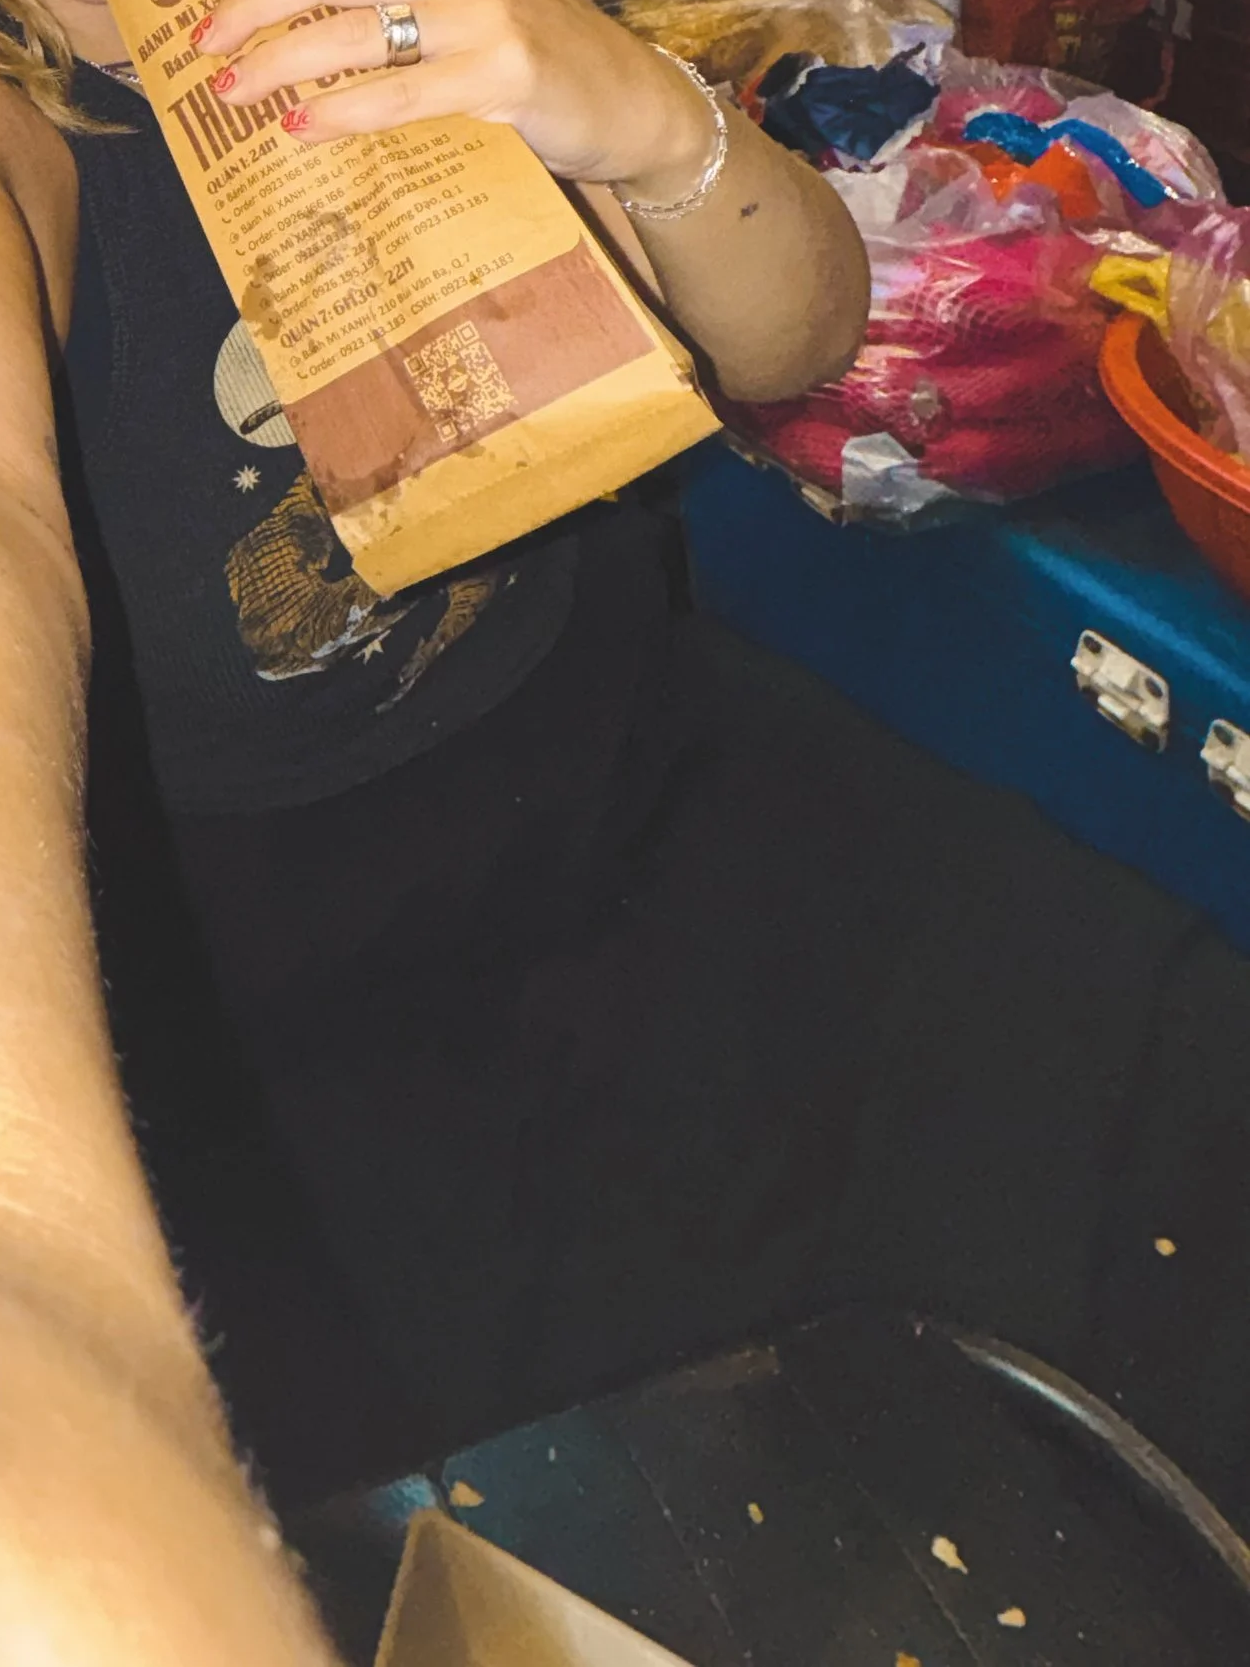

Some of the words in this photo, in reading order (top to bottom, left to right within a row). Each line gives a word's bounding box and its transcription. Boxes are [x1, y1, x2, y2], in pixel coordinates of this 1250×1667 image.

[138, 22, 174, 63] BÁNH
[174, 5, 198, 31] MÌ
[259, 156, 287, 178] XANH
[276, 188, 306, 210] XANH
[333, 282, 378, 316] 6H30
[384, 257, 414, 286] 22H
